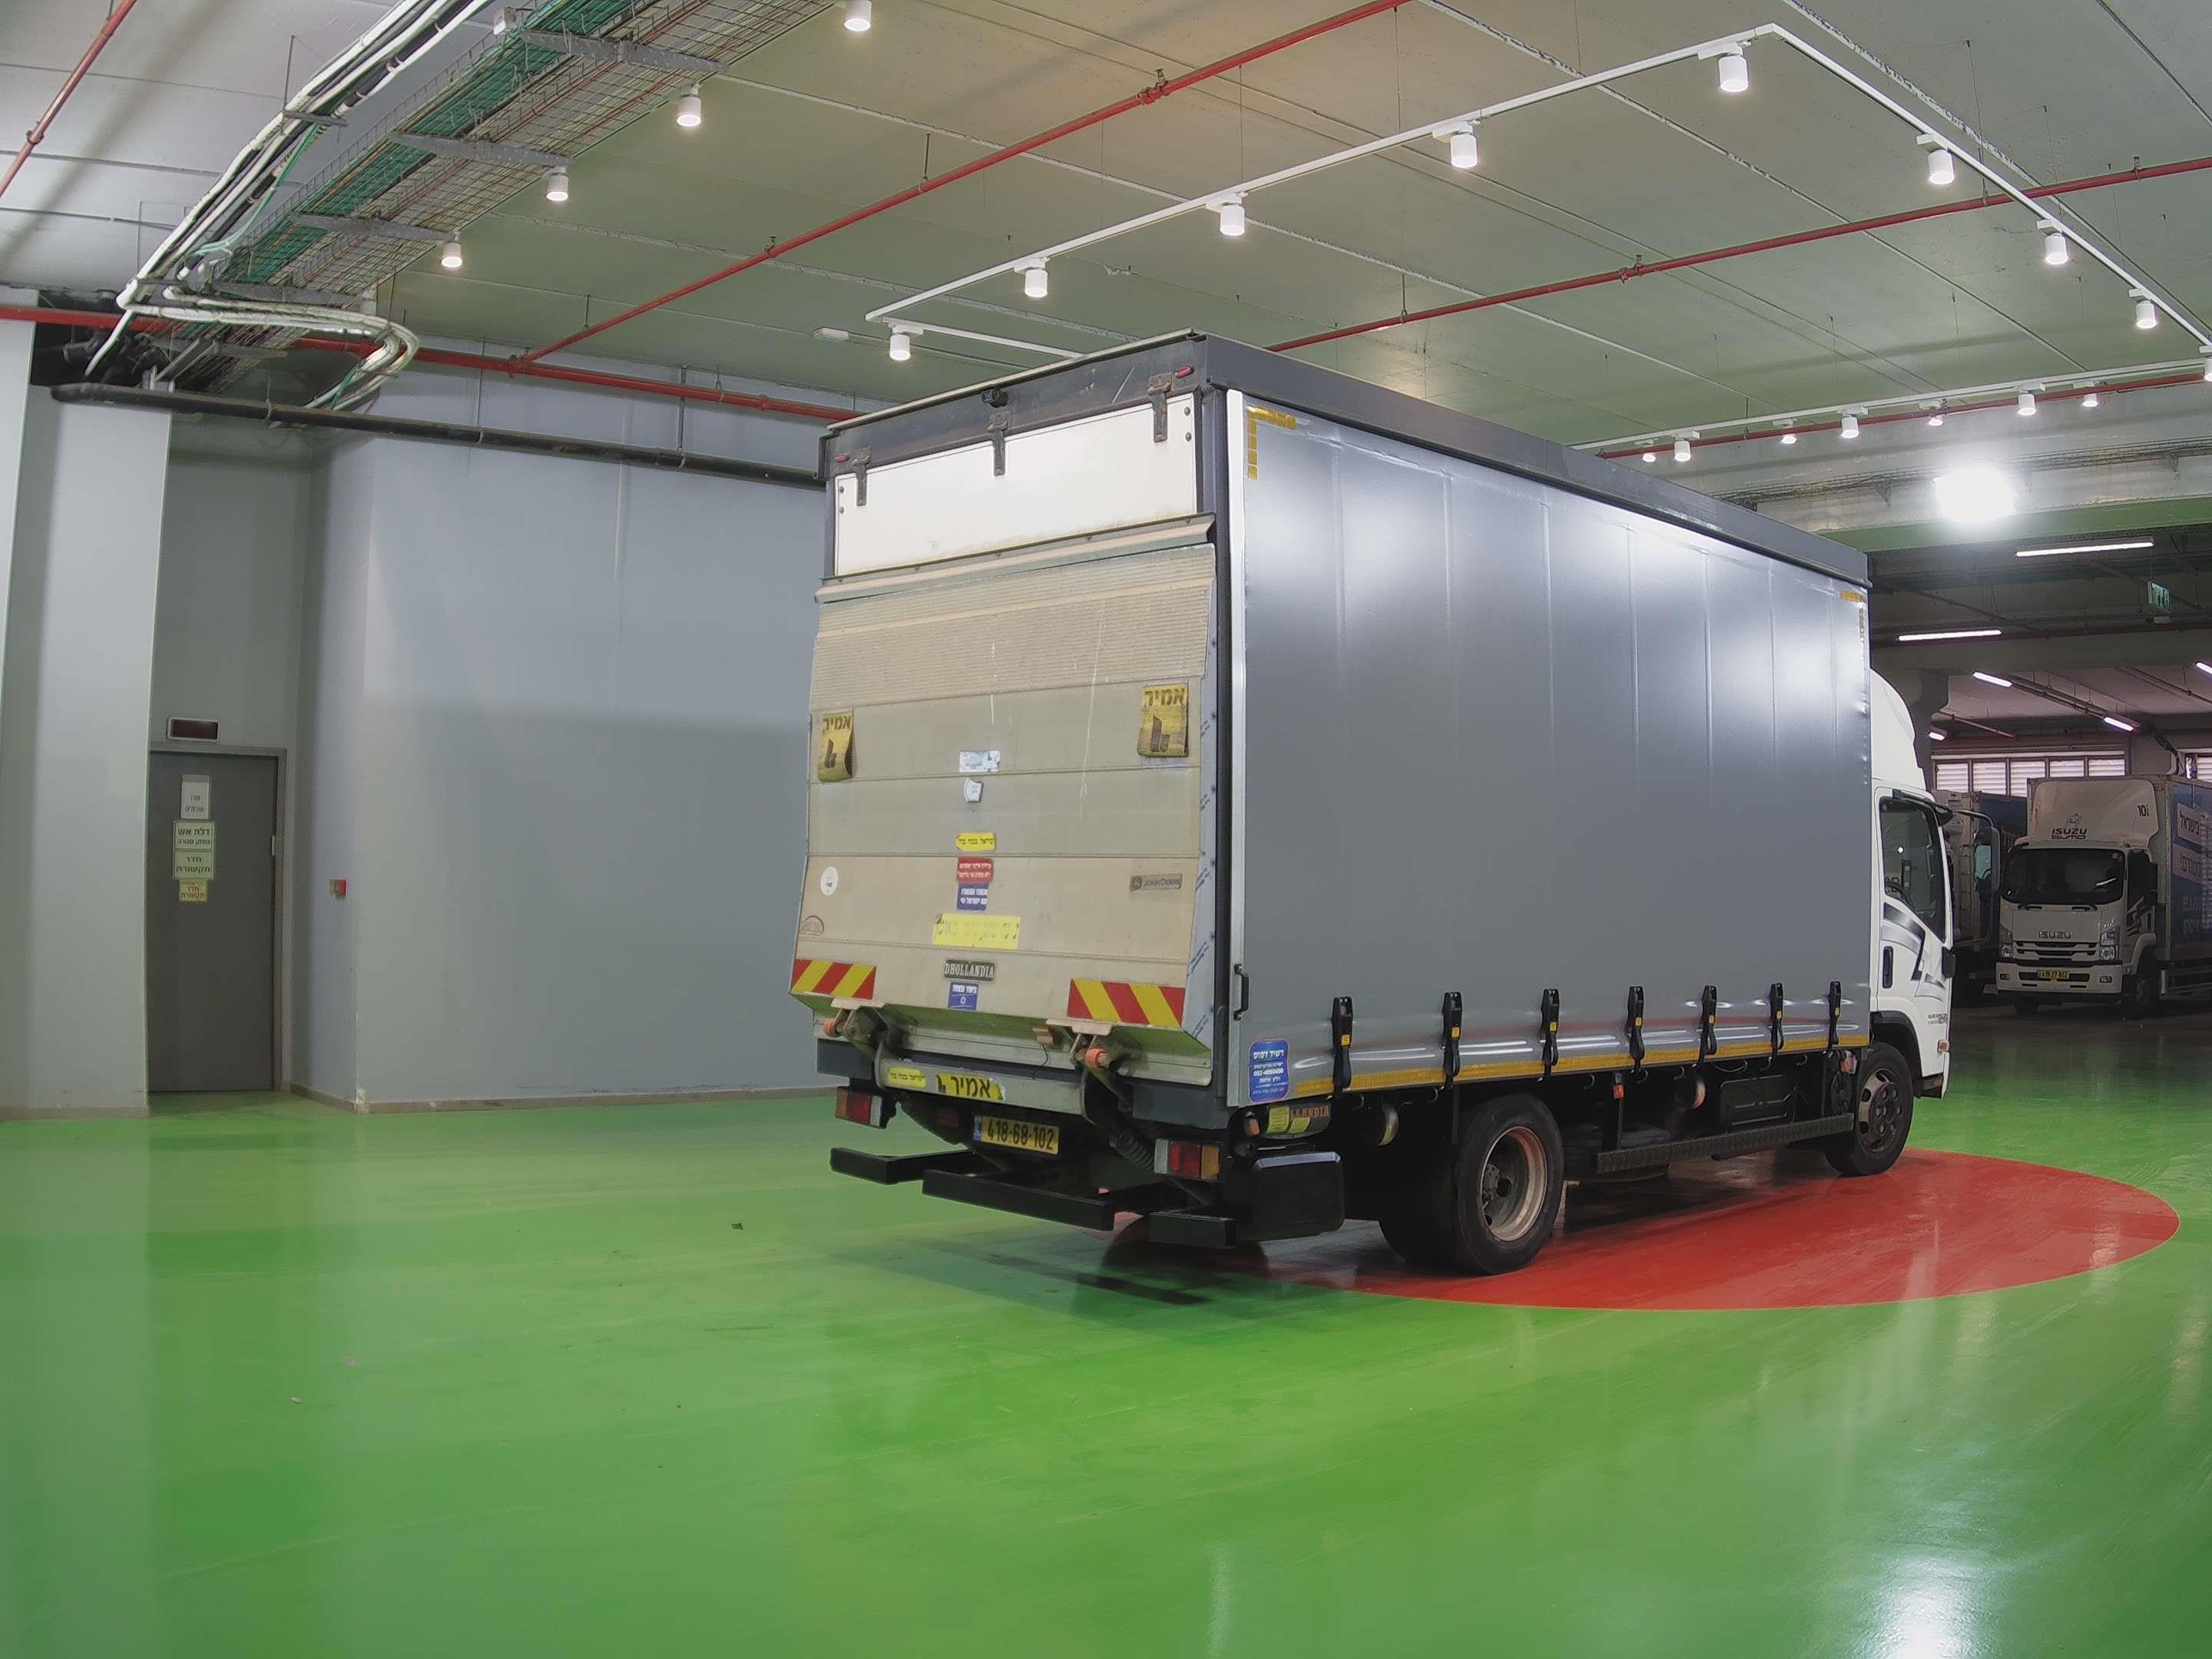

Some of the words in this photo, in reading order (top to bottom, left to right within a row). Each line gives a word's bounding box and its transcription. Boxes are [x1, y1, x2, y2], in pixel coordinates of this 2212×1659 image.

[194, 828, 210, 836] דלת
[175, 866, 210, 875] תקשורת
[944, 962, 995, 979] DHOLLANDIA
[950, 1075, 991, 1098] אמיר
